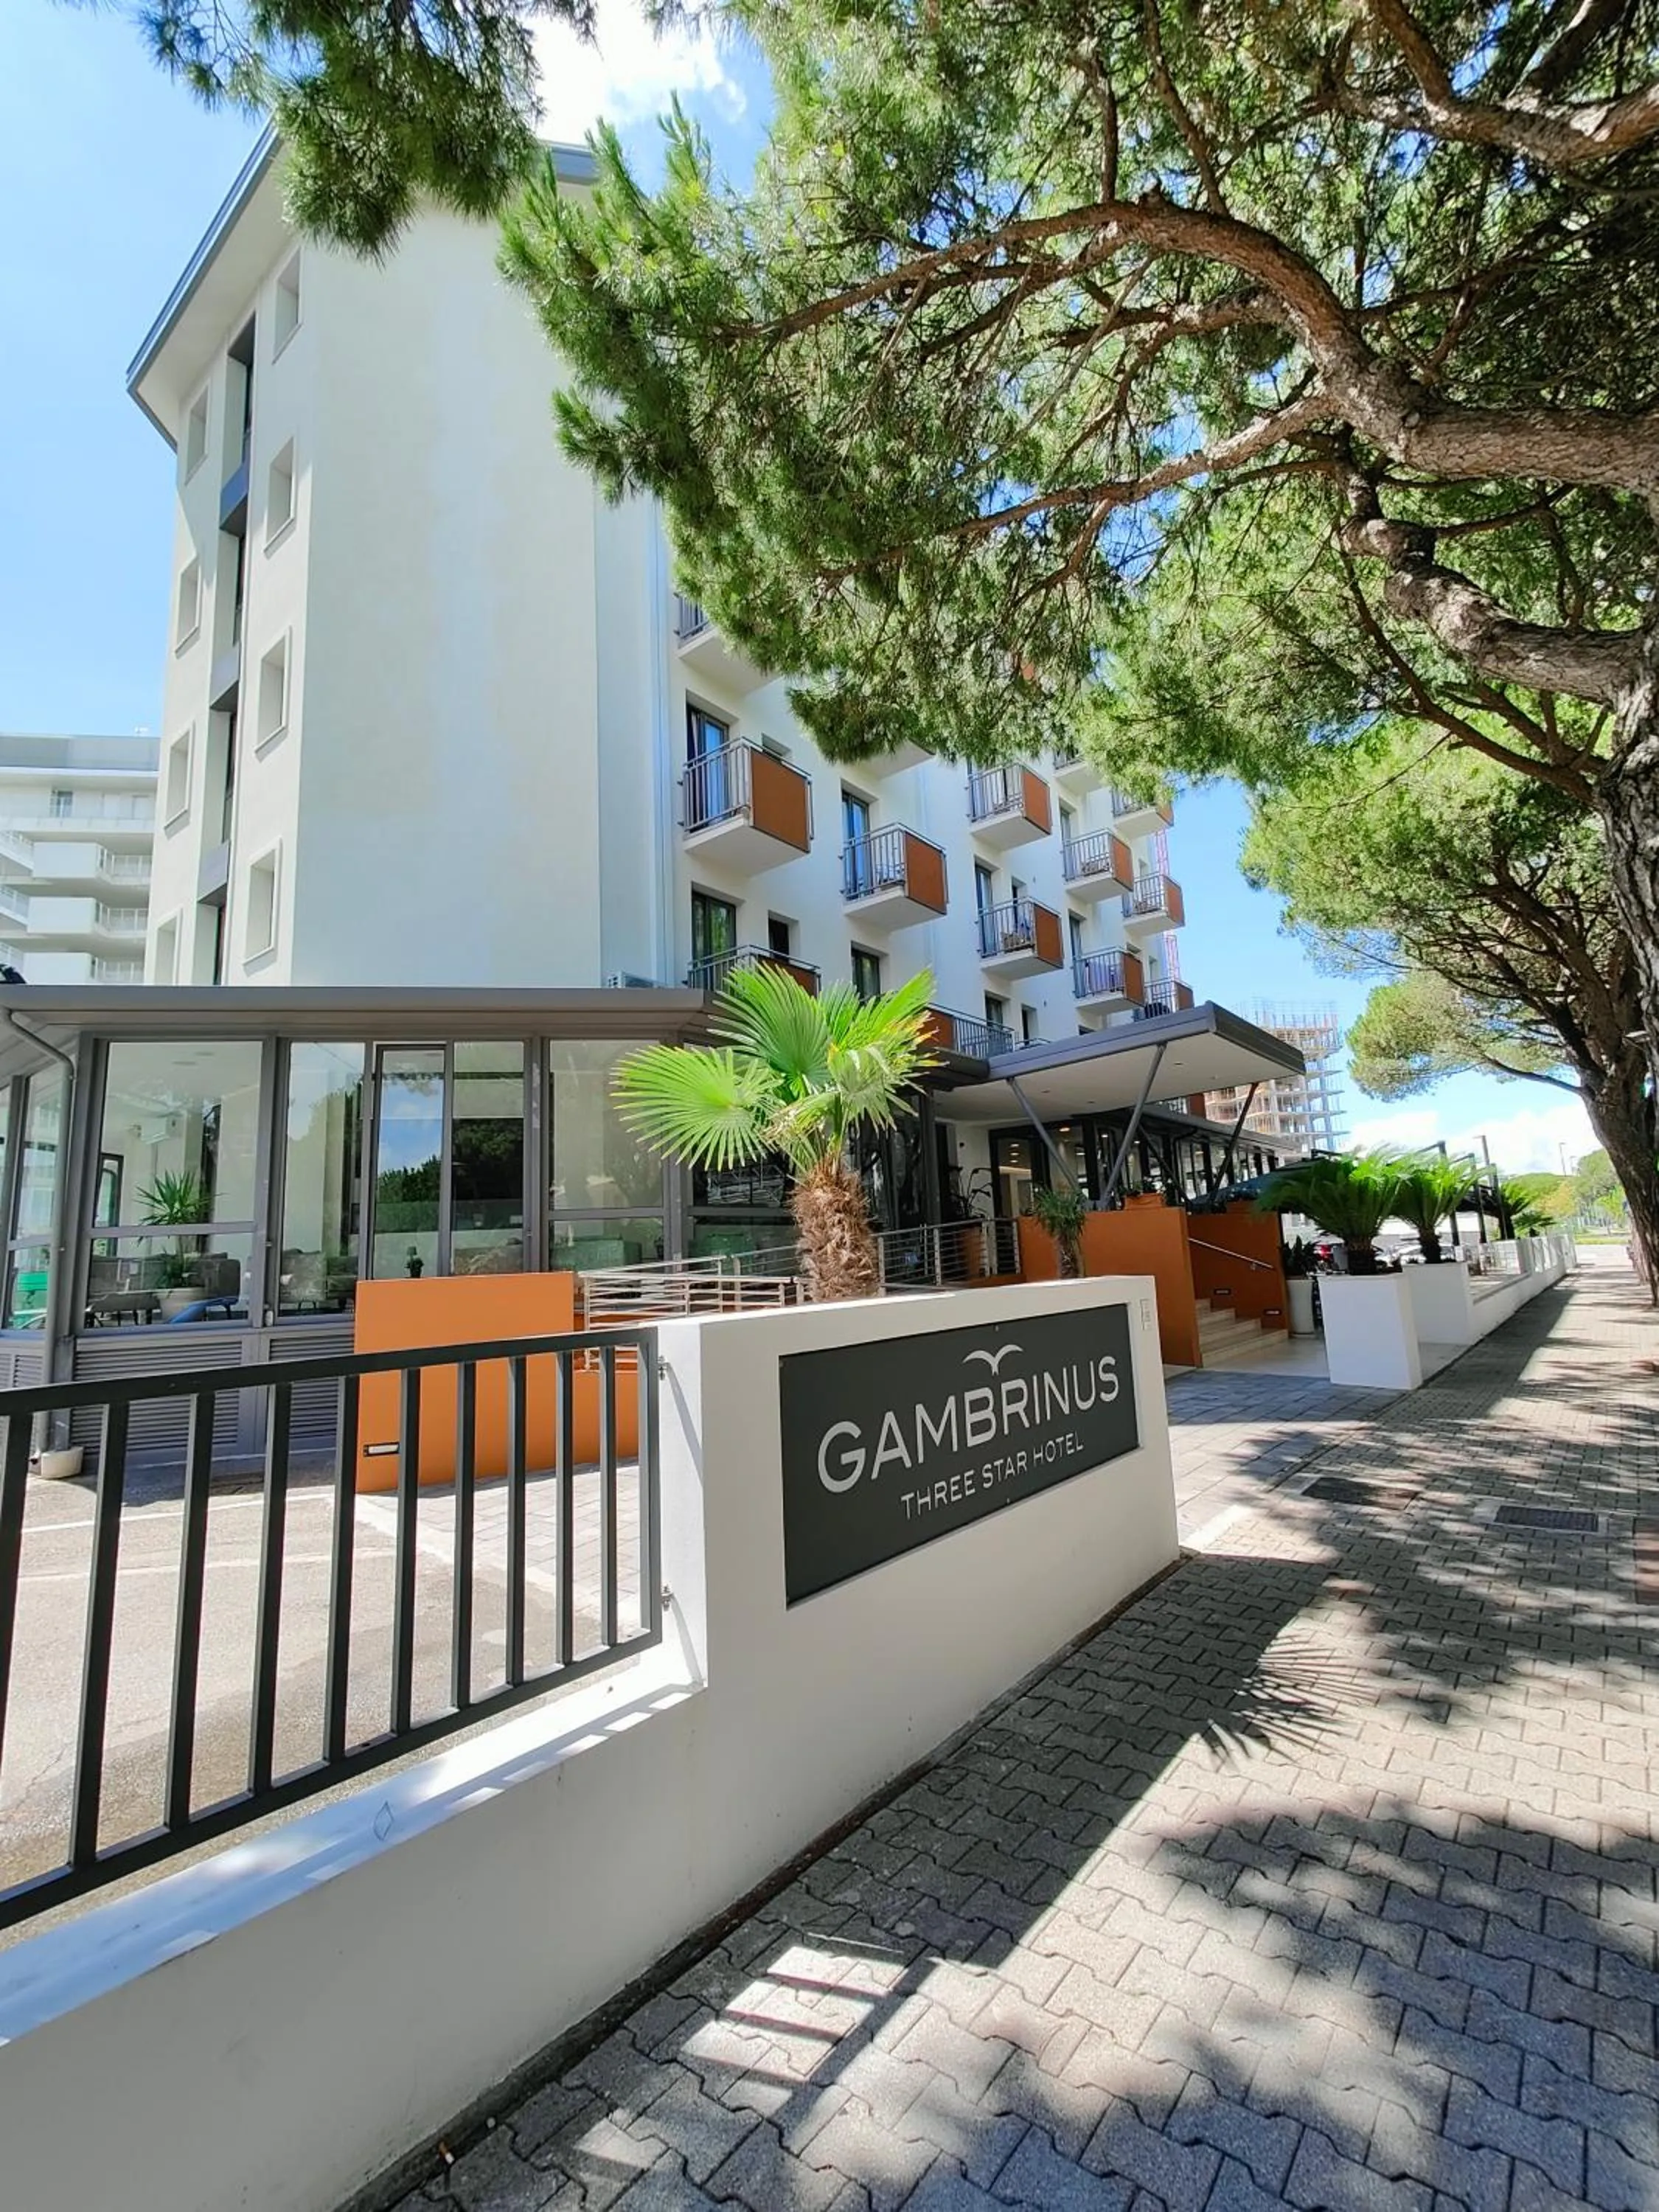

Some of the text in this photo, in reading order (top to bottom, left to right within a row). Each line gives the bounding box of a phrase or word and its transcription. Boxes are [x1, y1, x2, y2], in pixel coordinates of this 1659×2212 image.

[817, 1355, 1119, 1494] GAMBRINUS
[900, 1430, 1085, 1520] THREE STAR HOTEL
